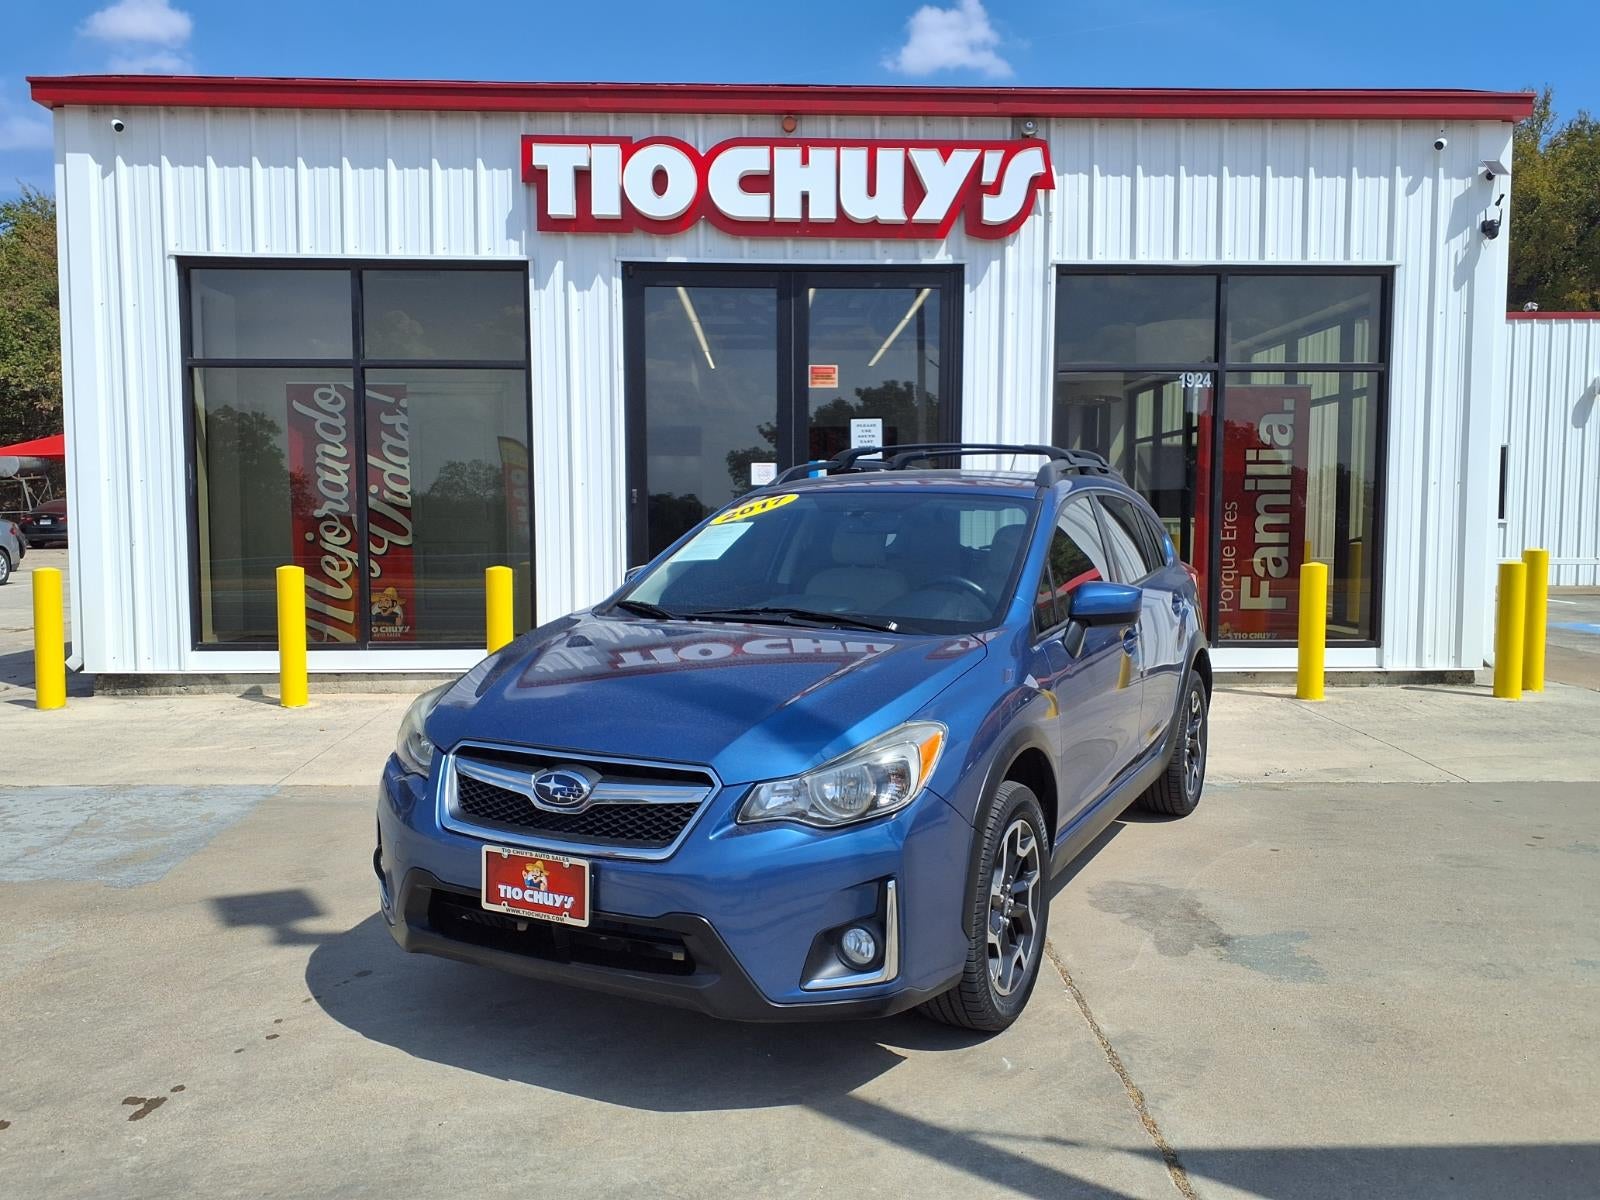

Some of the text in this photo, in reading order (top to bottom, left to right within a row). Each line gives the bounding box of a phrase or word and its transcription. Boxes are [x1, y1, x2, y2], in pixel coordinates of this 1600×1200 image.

[532, 143, 1046, 225] TIO CHUY'S
[1178, 371, 1212, 388] 1924
[292, 383, 380, 643] Mejorando
[721, 495, 788, 522] 2017
[1240, 399, 1295, 610] Familia.
[1219, 501, 1239, 612] Porque Eres
[551, 854, 570, 862] SALES
[498, 884, 574, 908] TIO CHUY'S
